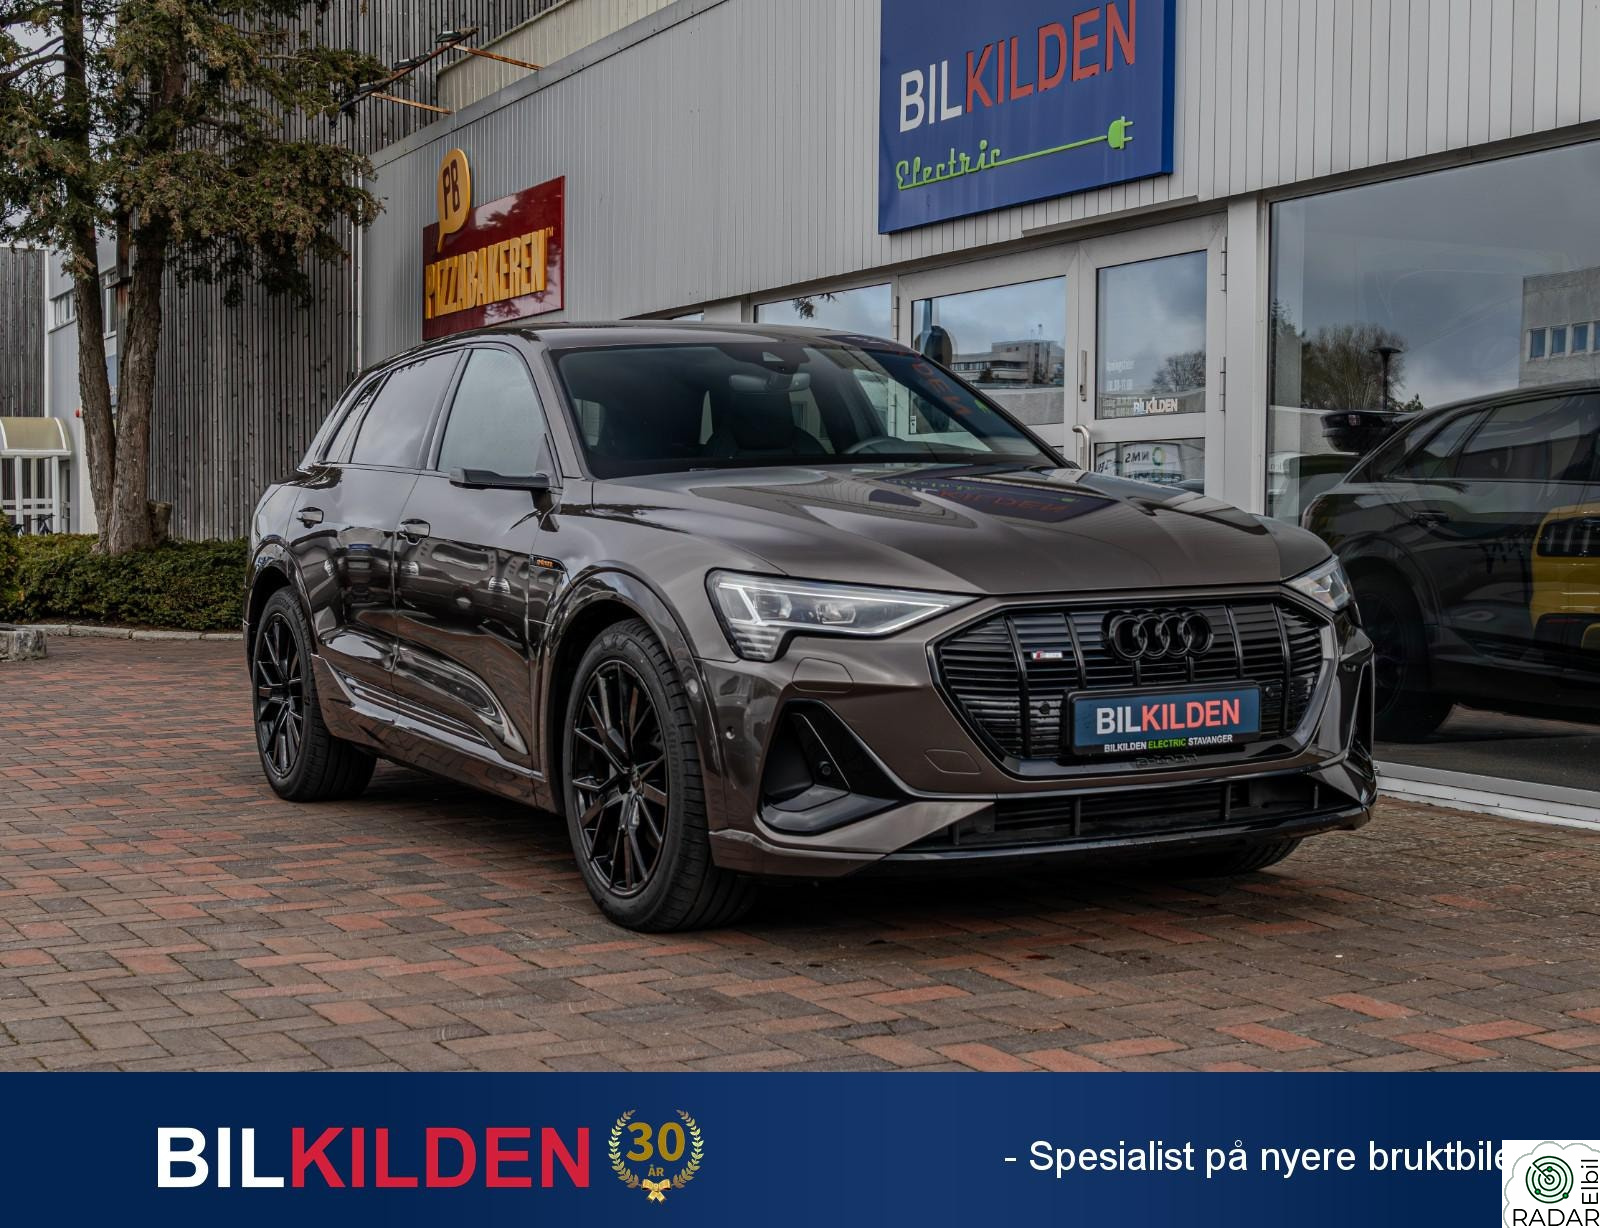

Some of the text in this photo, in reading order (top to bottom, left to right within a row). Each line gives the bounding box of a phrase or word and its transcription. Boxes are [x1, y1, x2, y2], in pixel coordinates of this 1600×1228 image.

[900, 0, 1136, 133] BILKILDEN
[442, 159, 461, 220] PB
[896, 140, 1001, 190] Electric
[425, 228, 546, 318] PIZZABAKEREN
[1096, 699, 1240, 735] BILKILDEN
[1104, 734, 1233, 753] BILKILDEN ELECTRIC STAVANGER
